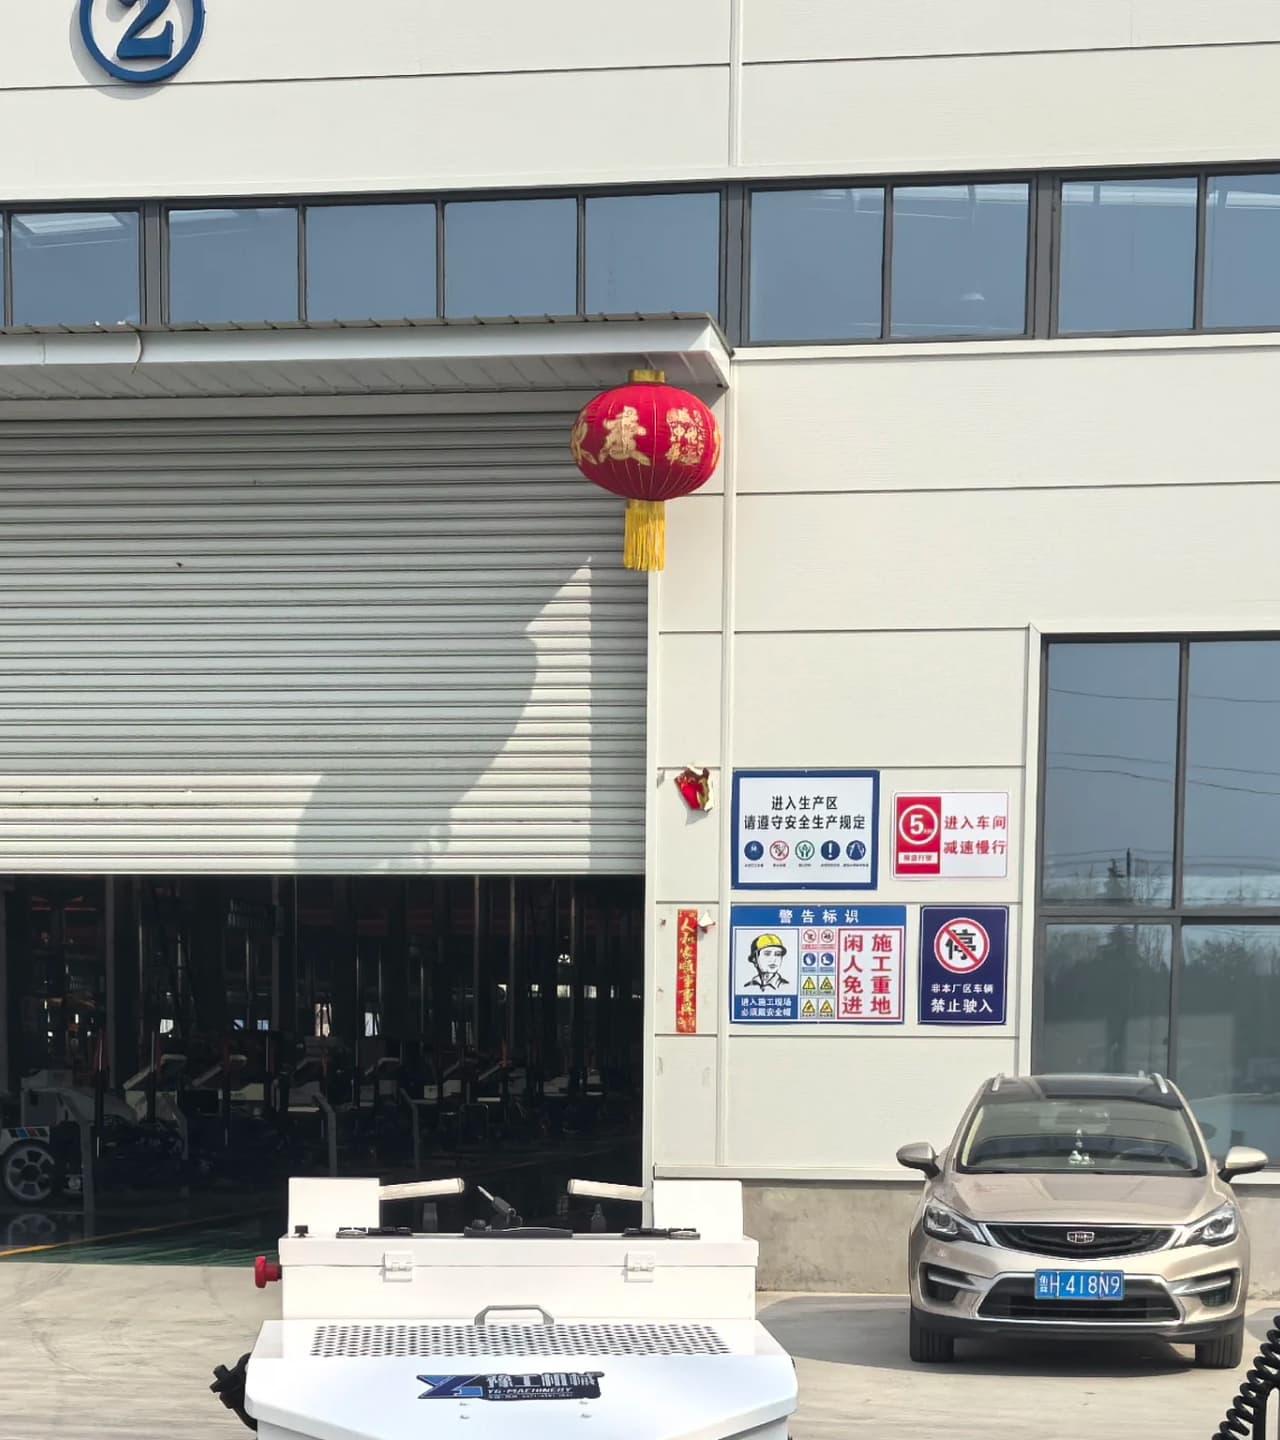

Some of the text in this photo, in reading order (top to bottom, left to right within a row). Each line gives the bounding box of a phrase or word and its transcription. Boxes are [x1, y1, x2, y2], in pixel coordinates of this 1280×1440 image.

[116, 0, 174, 59] 2
[771, 795, 838, 811] 进入生产区
[744, 815, 866, 830] 请遵守安全生产规定
[910, 814, 924, 835] 5
[944, 815, 1006, 830] 进入车间
[943, 840, 1007, 855] 减速慢行
[779, 909, 859, 924] 警告标识
[842, 934, 864, 1015] 闲人免进
[871, 934, 892, 1015] 施工重地
[931, 983, 994, 993] 非本厂区车辆
[741, 997, 792, 1007] 进入施工现场
[931, 998, 993, 1013] 禁止驶入
[741, 1007, 792, 1017] 必须戴安全帽
